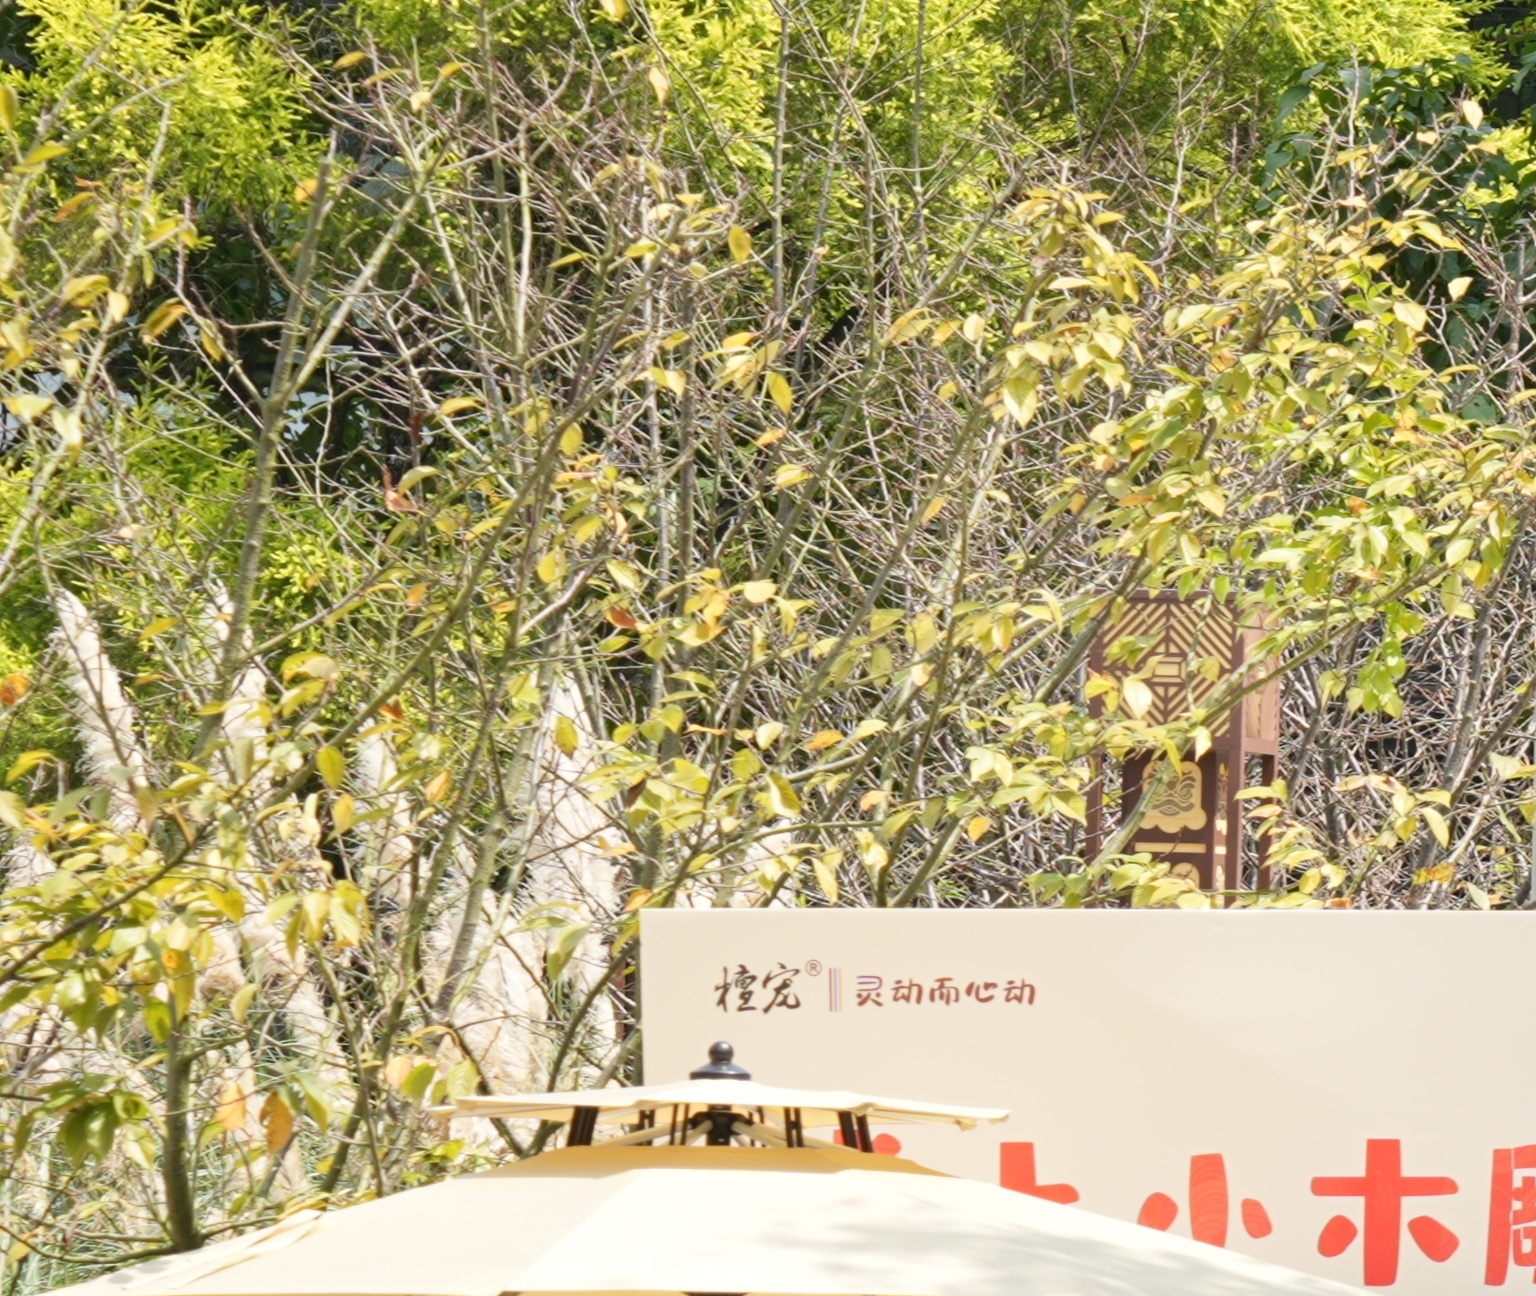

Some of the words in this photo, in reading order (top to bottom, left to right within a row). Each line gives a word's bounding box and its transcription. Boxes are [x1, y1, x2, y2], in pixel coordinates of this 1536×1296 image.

[855, 974, 1036, 1007] 灵动而心动
